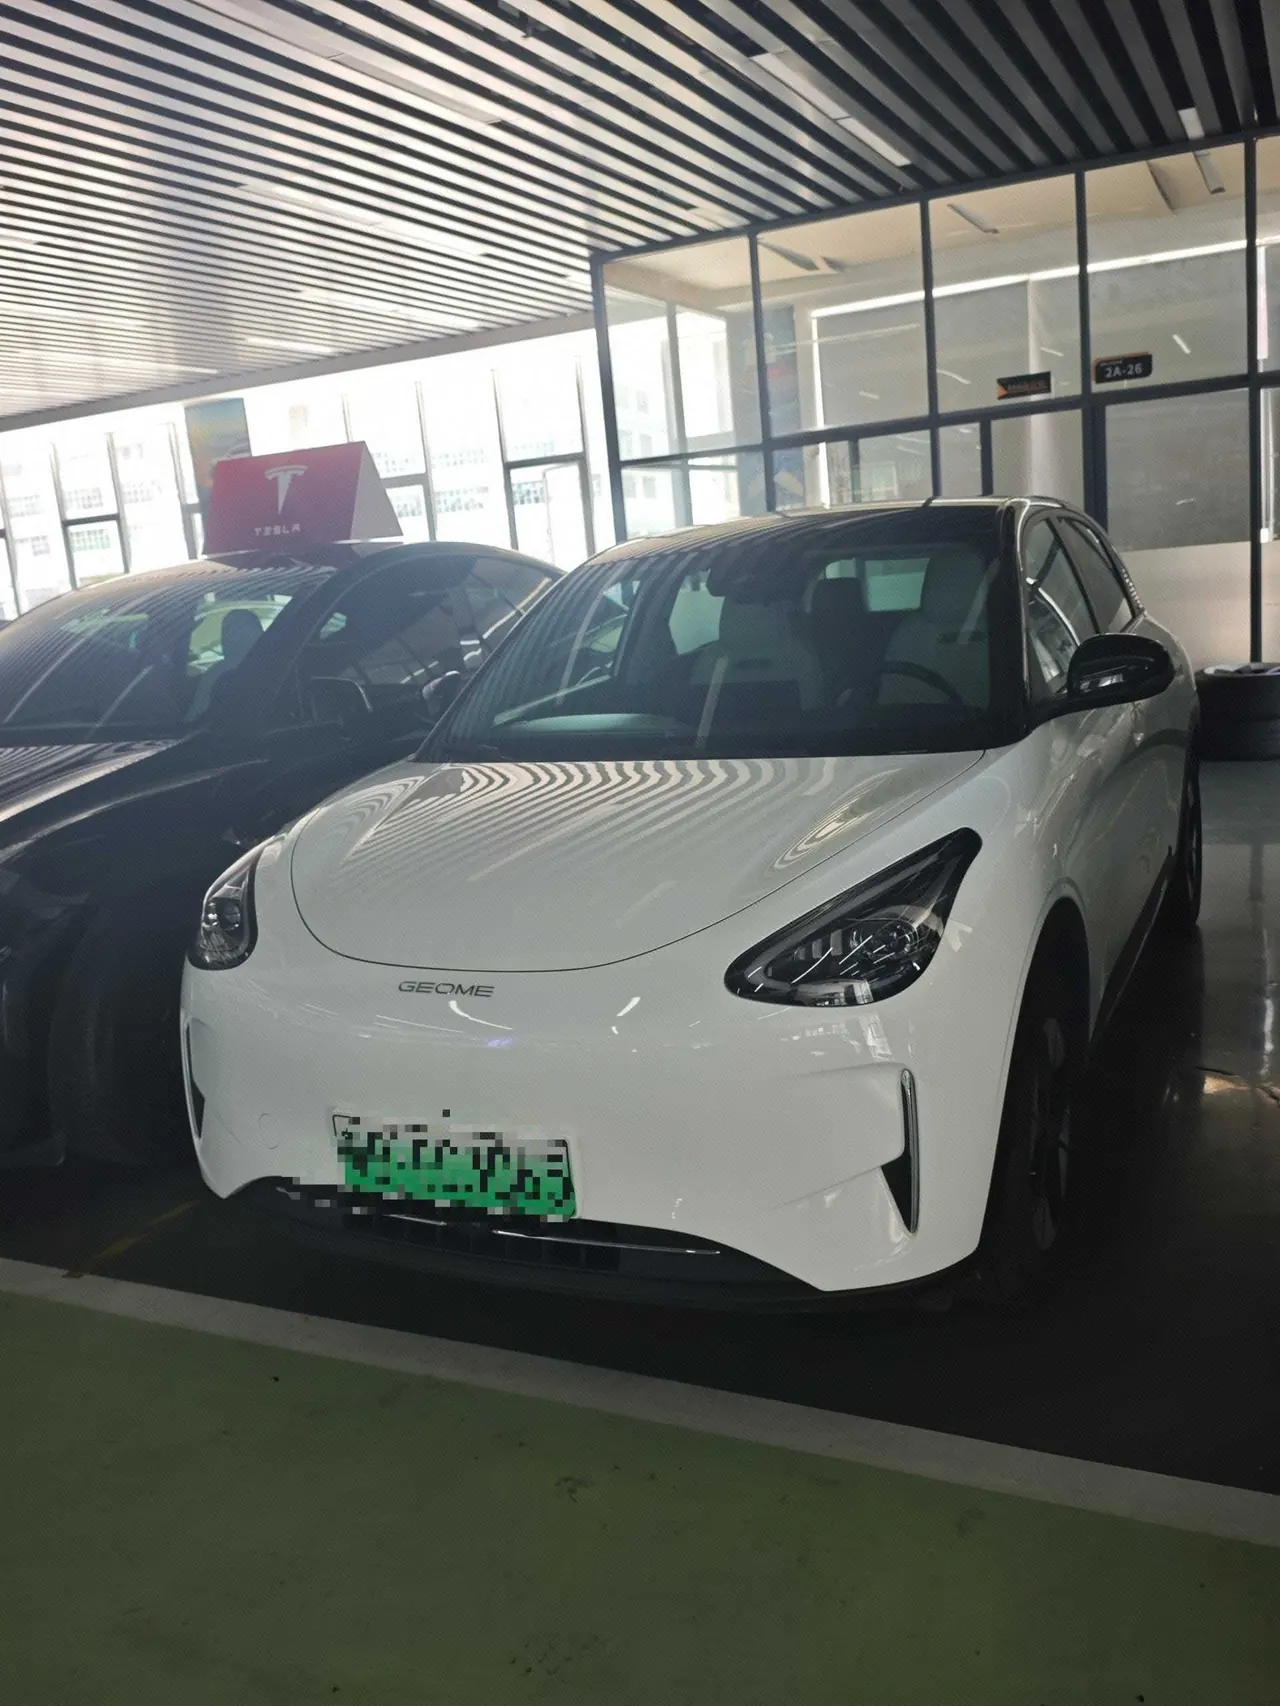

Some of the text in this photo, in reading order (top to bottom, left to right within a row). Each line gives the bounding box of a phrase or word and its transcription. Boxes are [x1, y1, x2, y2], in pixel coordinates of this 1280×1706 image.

[1104, 362, 1143, 379] 2A-26
[254, 523, 301, 537] TESLA
[398, 980, 495, 998] GEOME
